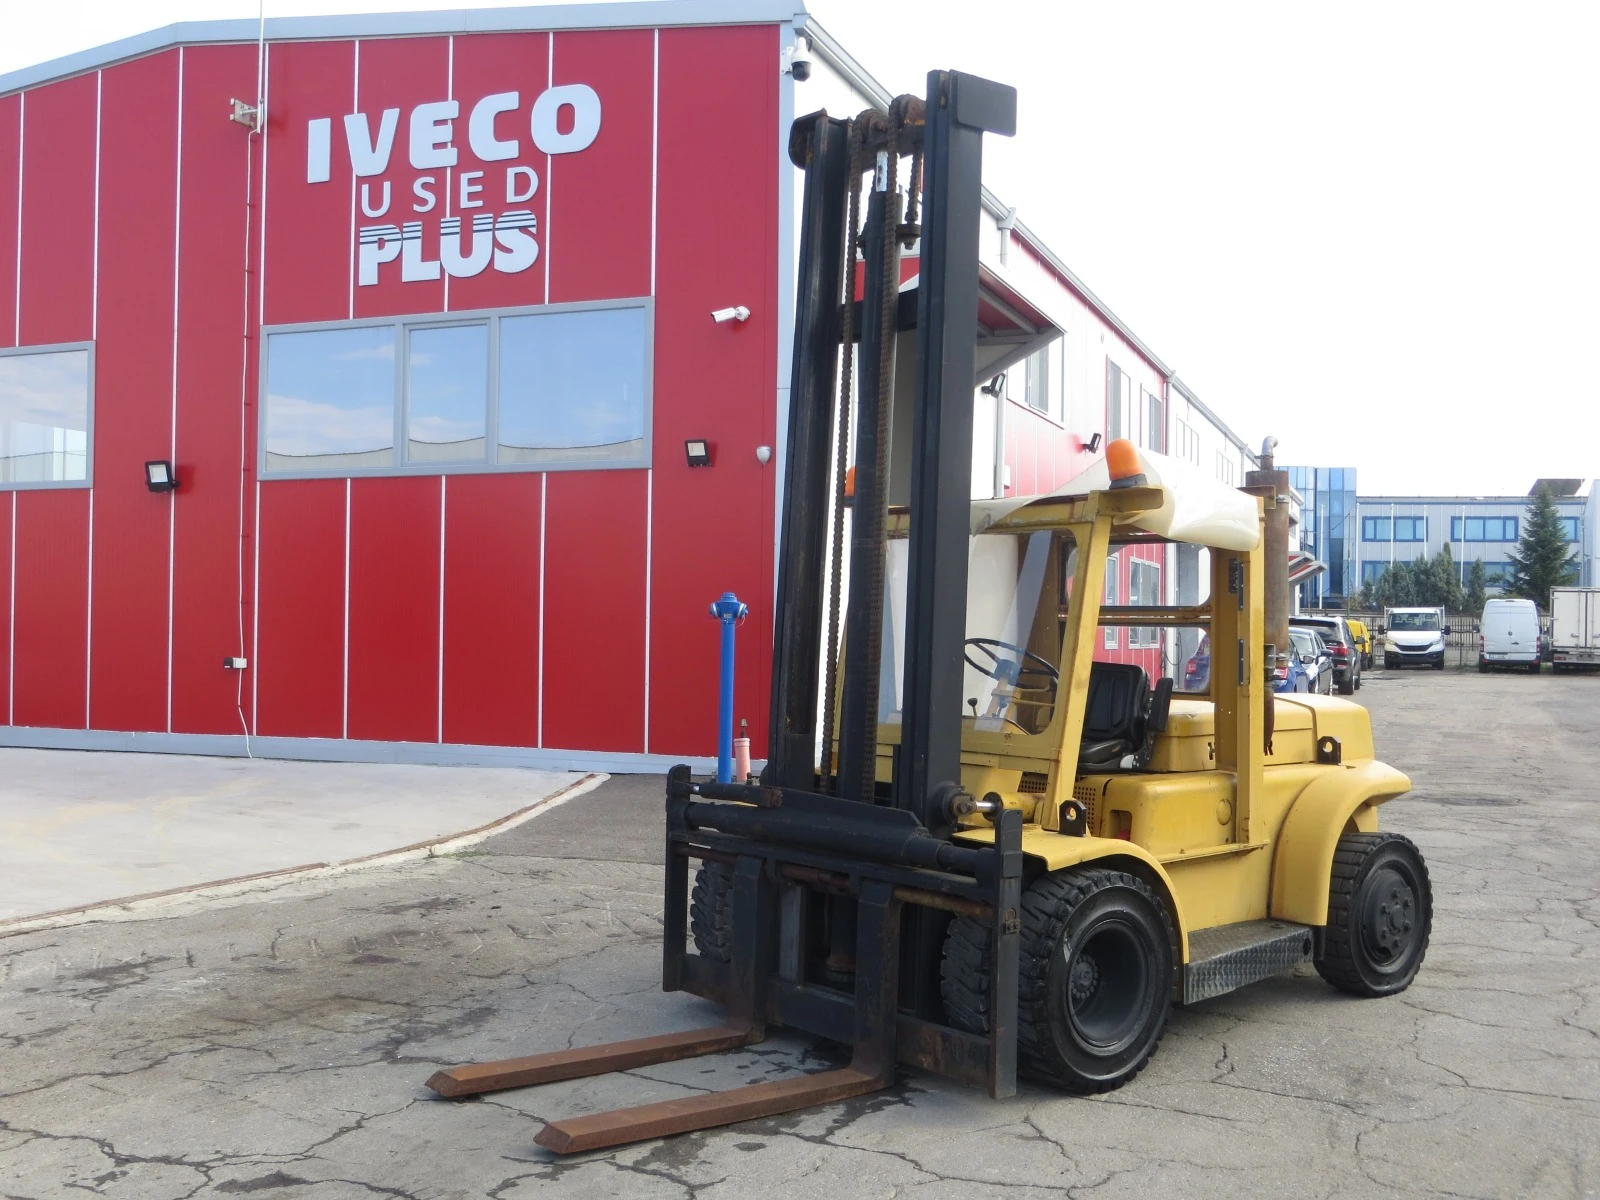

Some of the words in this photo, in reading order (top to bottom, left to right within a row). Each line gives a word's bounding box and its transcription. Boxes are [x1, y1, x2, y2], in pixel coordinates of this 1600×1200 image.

[307, 83, 602, 184] IVECO
[361, 166, 539, 218] USED
[358, 209, 539, 286] PLUS
